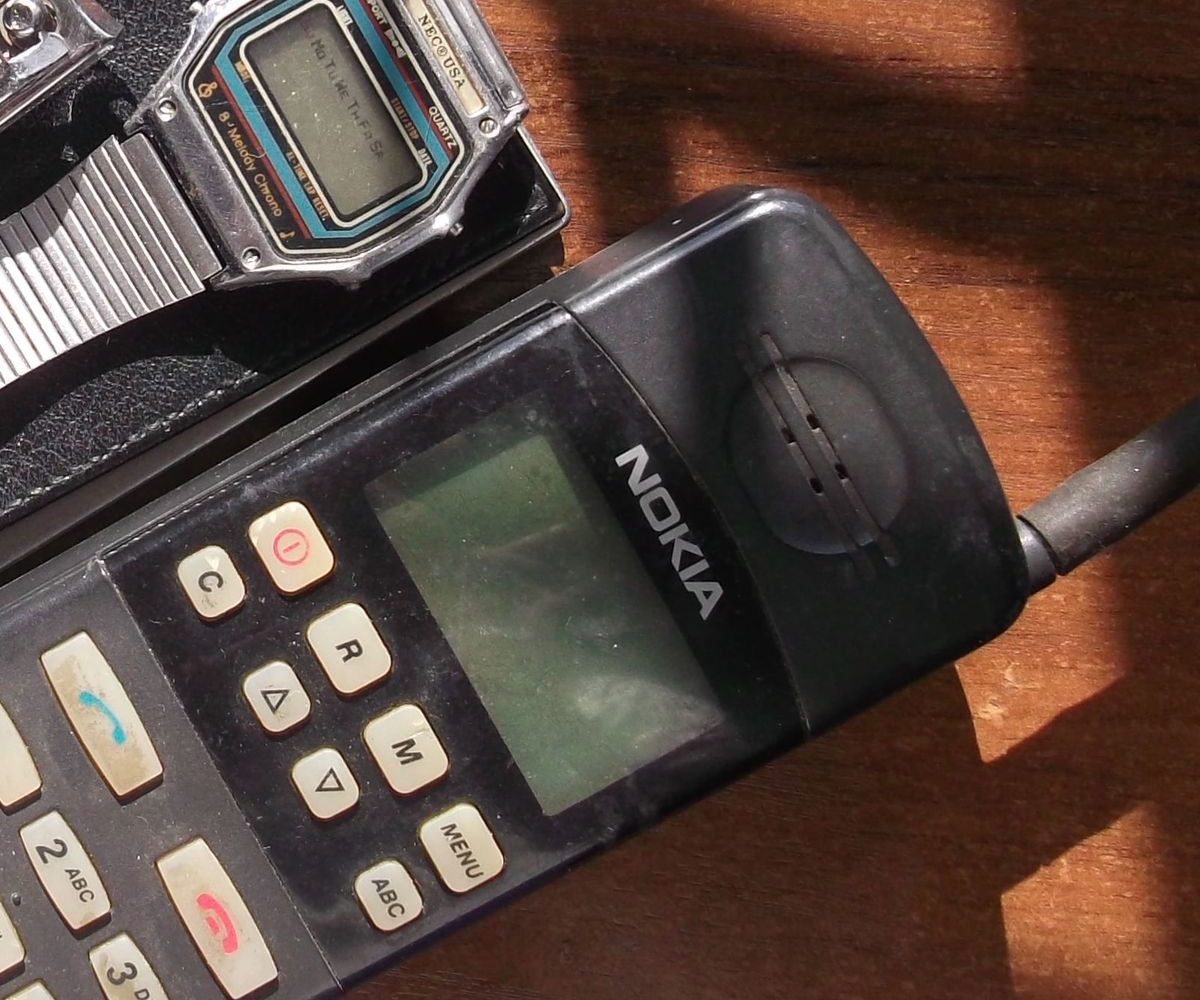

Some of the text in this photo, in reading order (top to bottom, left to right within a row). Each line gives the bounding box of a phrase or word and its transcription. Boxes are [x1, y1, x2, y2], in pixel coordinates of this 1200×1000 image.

[227, 124, 257, 171] Melody
[426, 104, 457, 149] QUARTZ
[615, 444, 725, 621] NOKIA
[198, 570, 225, 594] C
[335, 639, 364, 664] R
[391, 739, 423, 765] M
[35, 838, 95, 904] 2 ABC
[440, 821, 485, 880] MENU
[370, 876, 406, 920] ABC
[107, 962, 138, 985] 3
